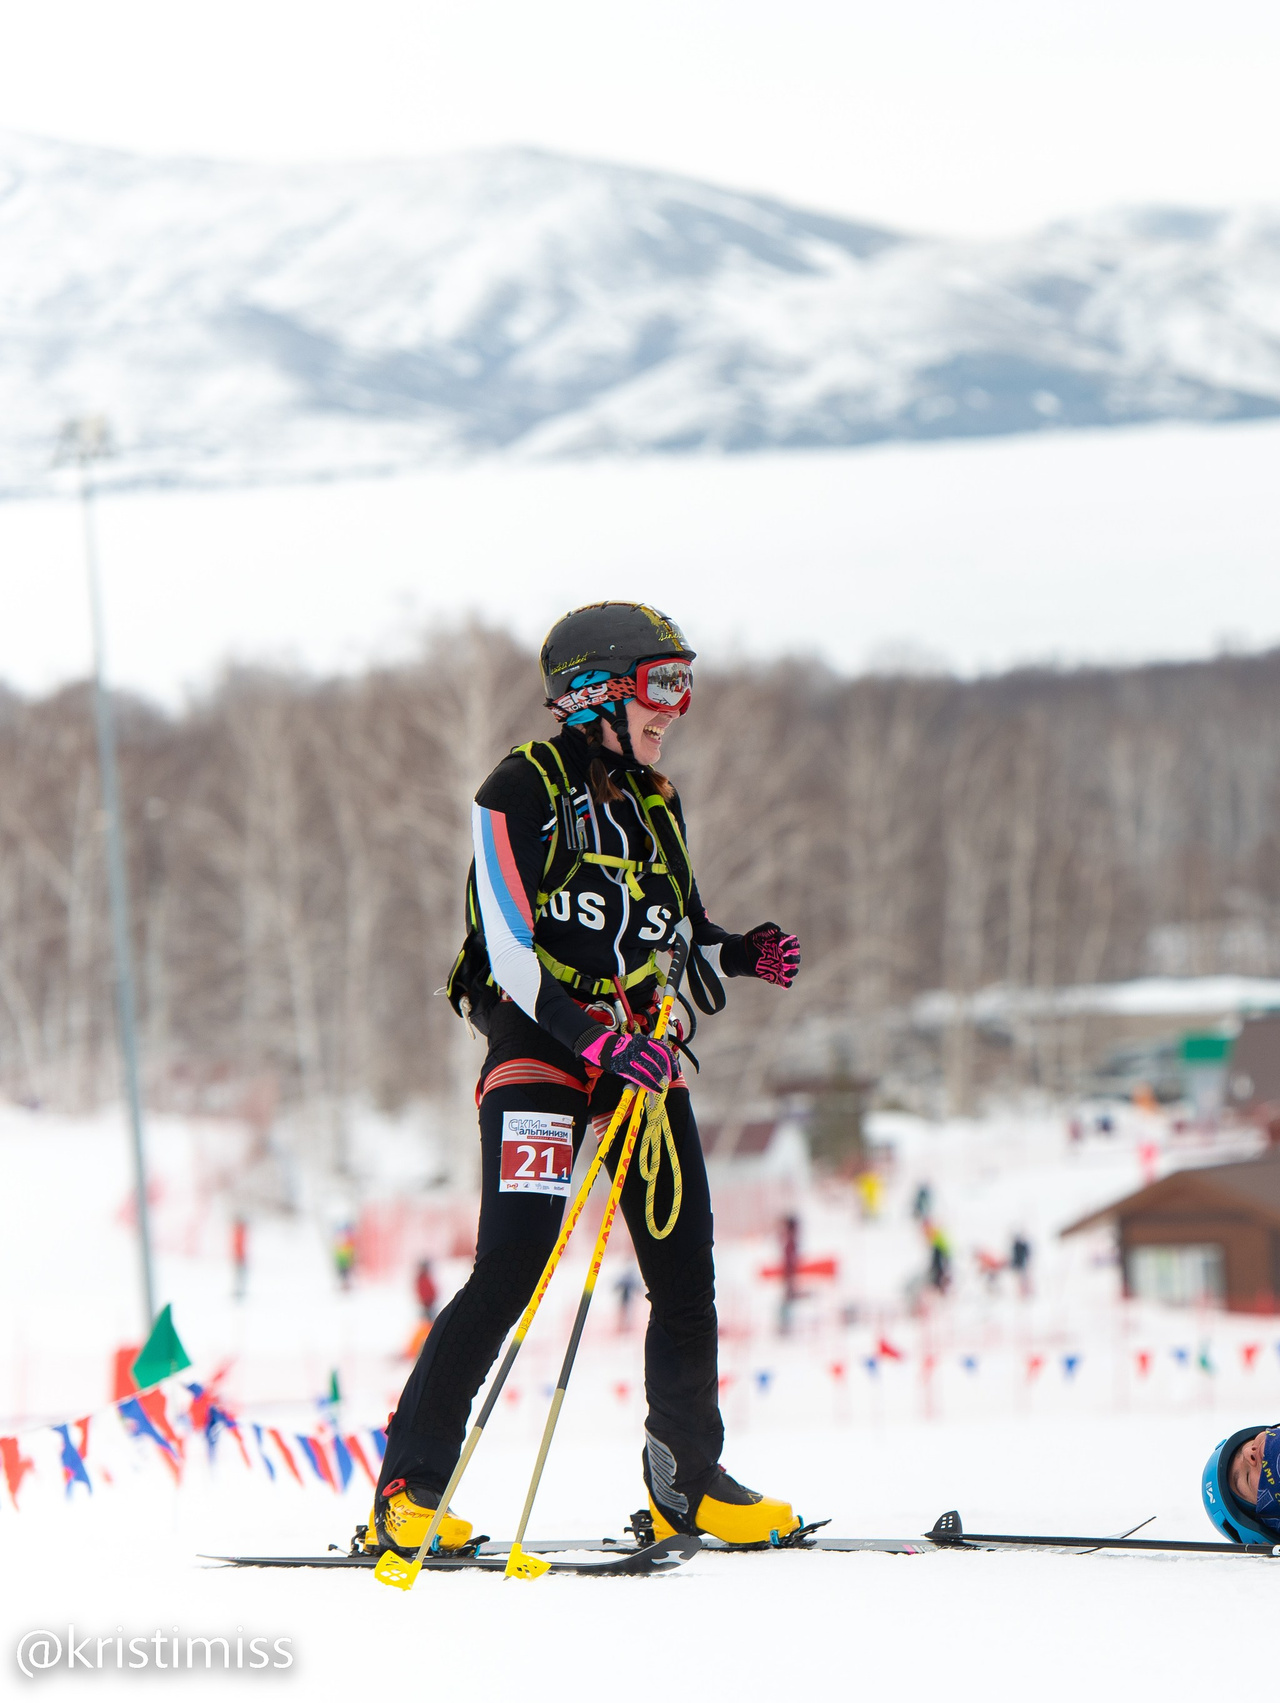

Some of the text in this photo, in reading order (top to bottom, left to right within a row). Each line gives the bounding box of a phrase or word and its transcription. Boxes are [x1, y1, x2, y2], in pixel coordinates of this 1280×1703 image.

[557, 683, 608, 708] SKY
[519, 1128, 568, 1139] альпинизм
[514, 1145, 569, 1180] 21 1
[1262, 1460, 1275, 1485] AMP
